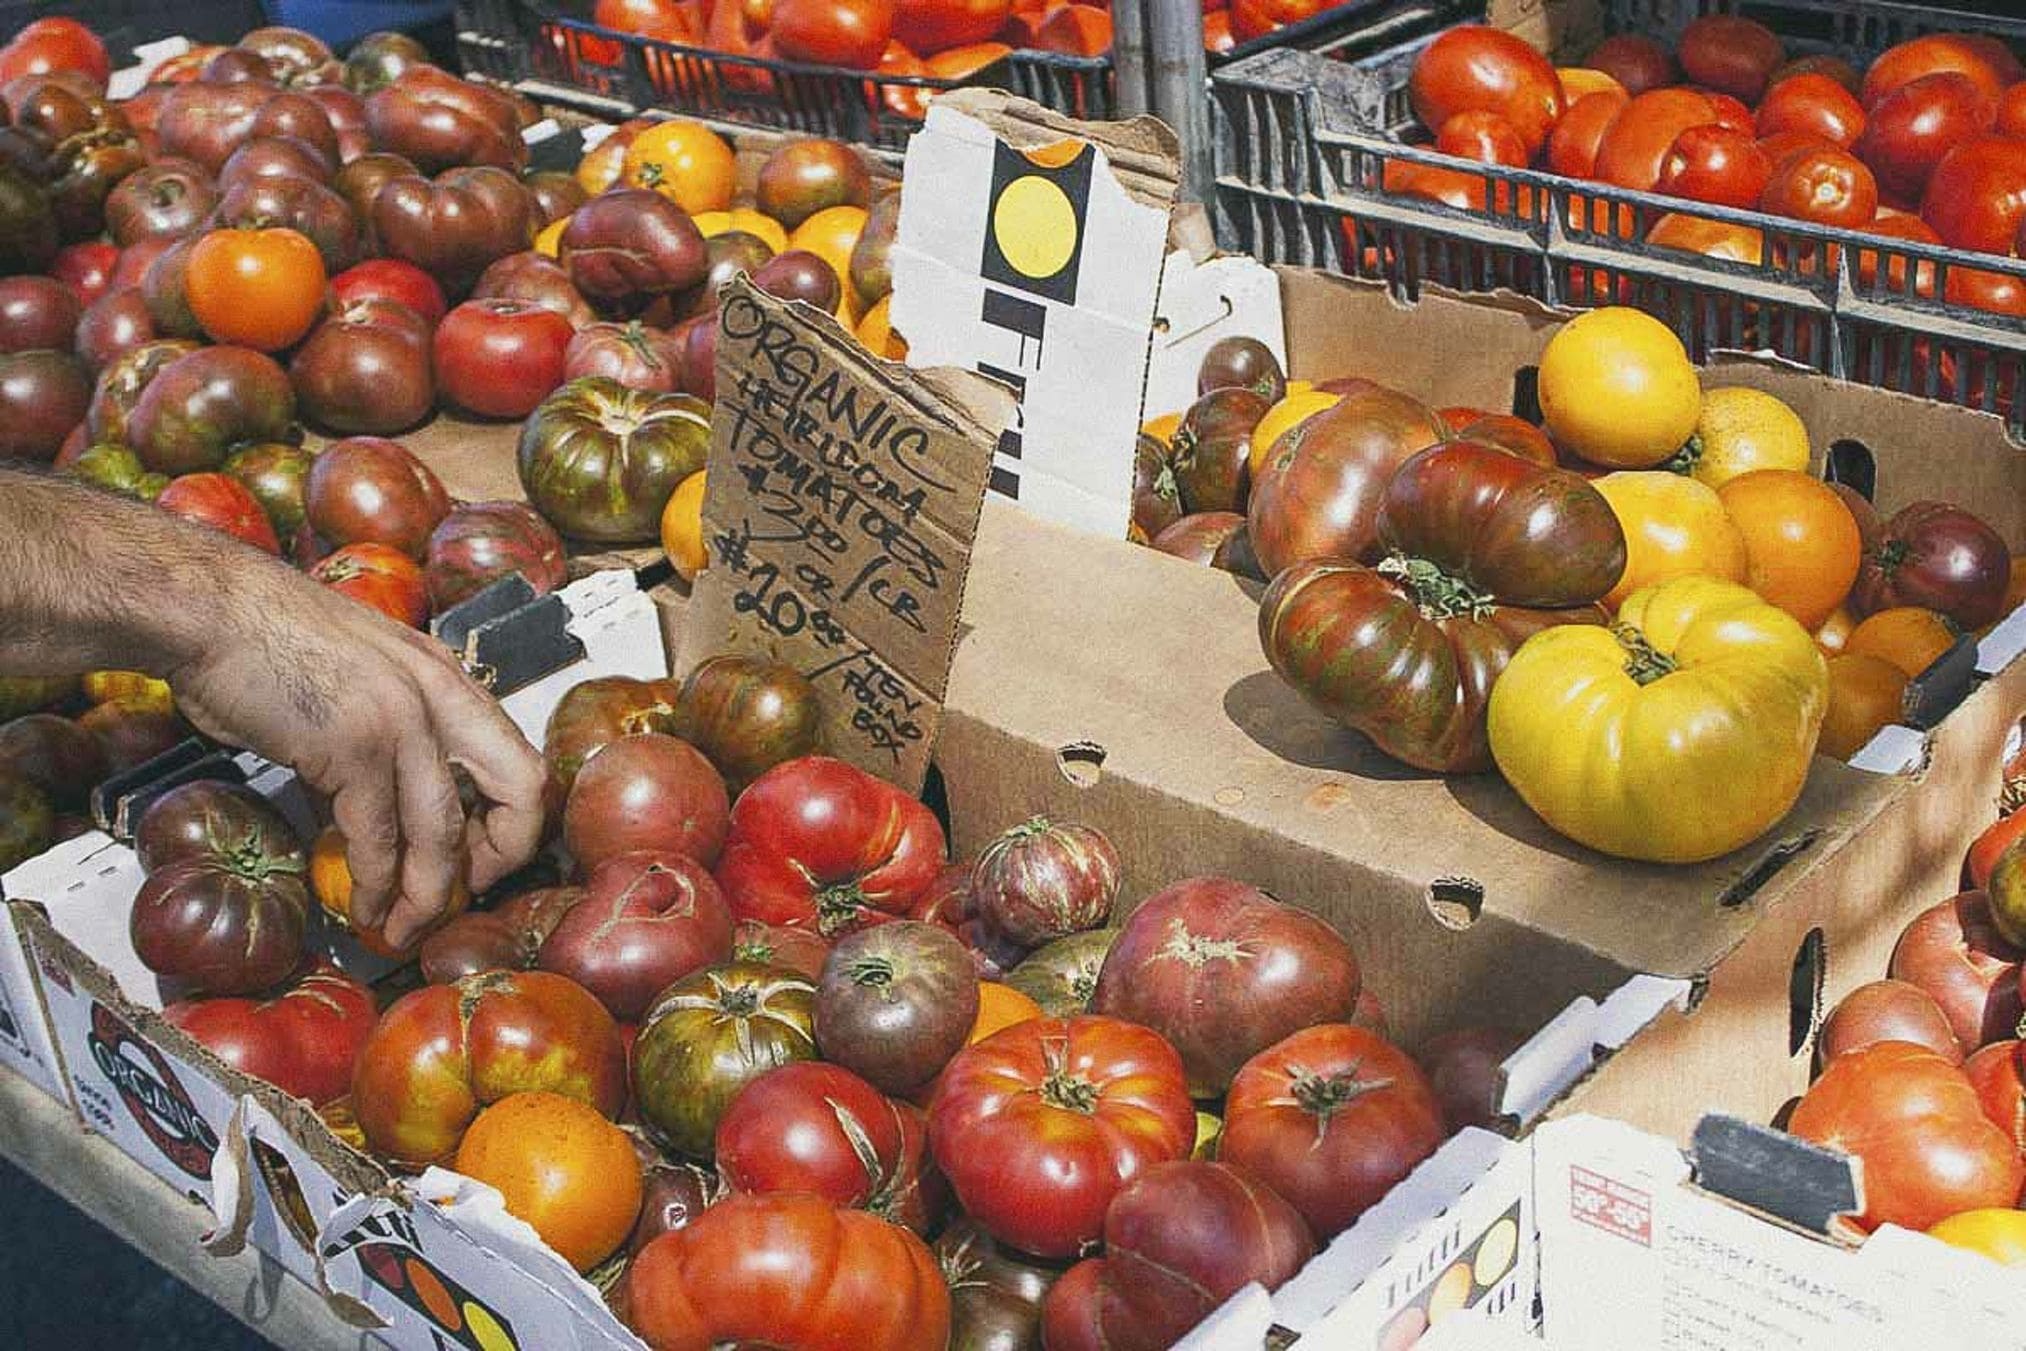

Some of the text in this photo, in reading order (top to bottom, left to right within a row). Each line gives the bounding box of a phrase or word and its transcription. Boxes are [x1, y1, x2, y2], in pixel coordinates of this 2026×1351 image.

[722, 295, 957, 493] ORGANIC
[736, 371, 927, 527] HEIRLOOM
[722, 401, 946, 588] TOMATOES
[796, 565, 833, 602] OR
[842, 669, 924, 739] POUND
[852, 707, 906, 766] BOX
